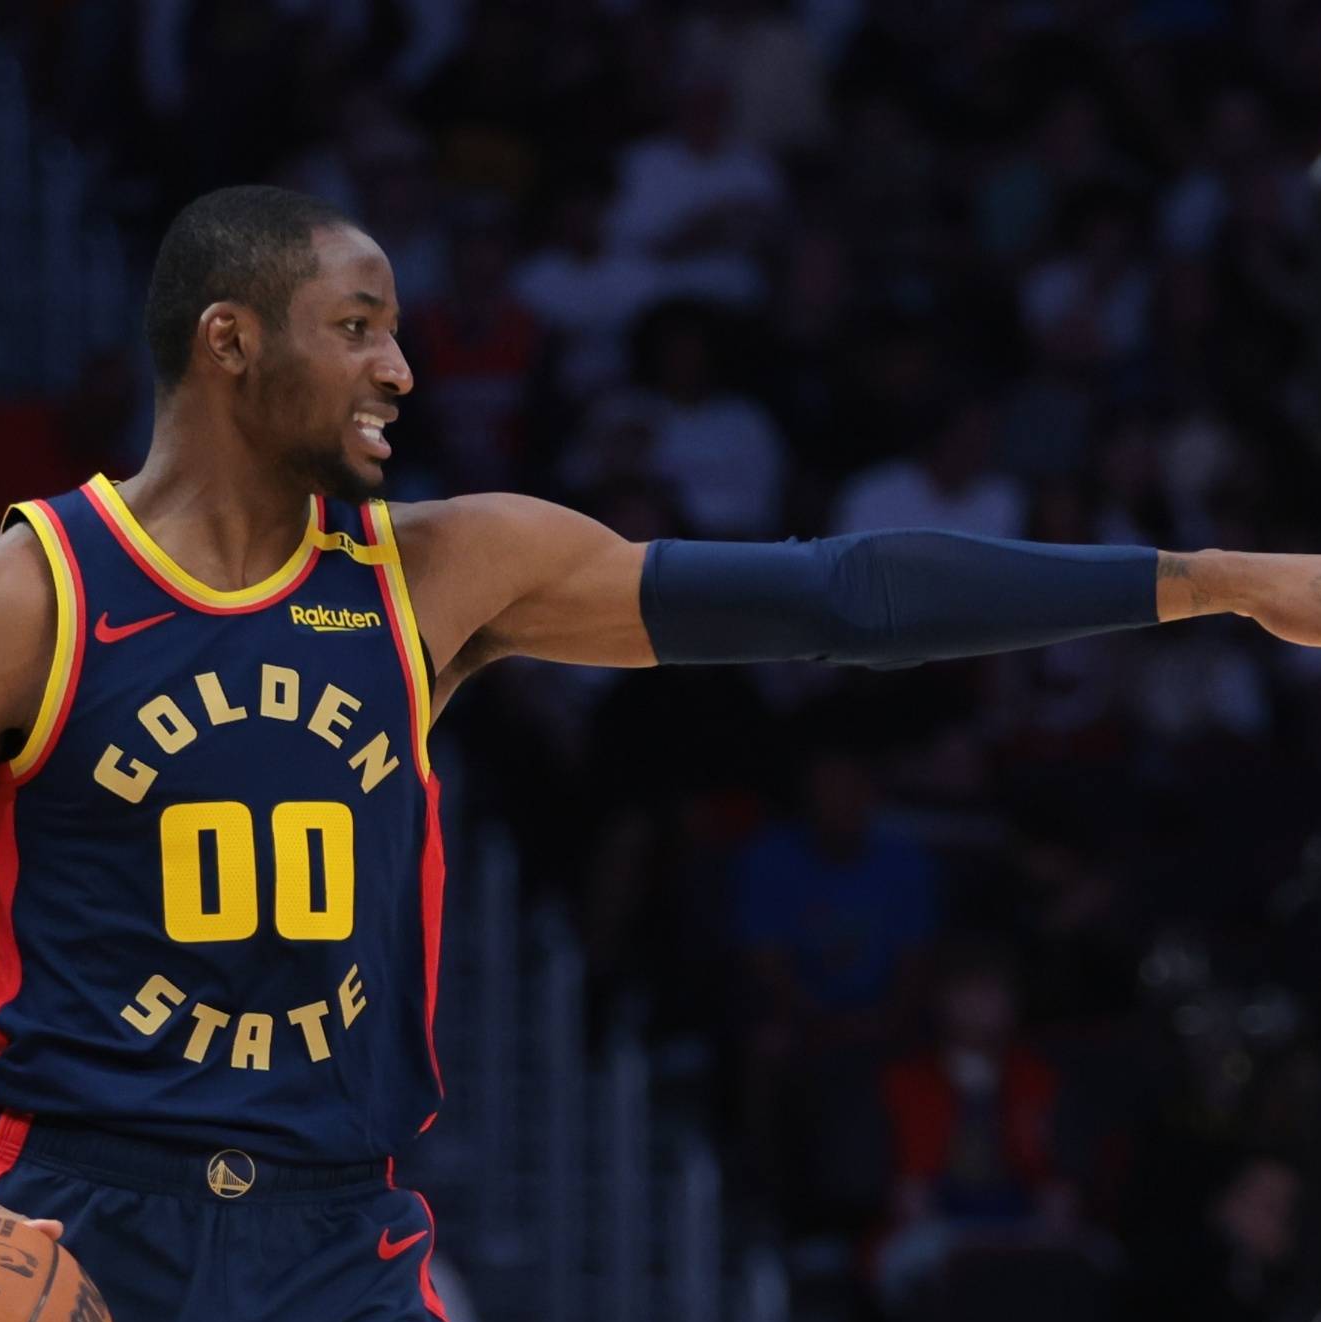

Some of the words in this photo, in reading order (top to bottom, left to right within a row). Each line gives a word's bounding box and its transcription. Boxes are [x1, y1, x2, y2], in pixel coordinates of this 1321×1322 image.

[290, 605, 381, 628] Rakuten
[93, 663, 400, 804] GOLDEN
[159, 800, 356, 943] 00
[120, 964, 367, 1071] STATE
